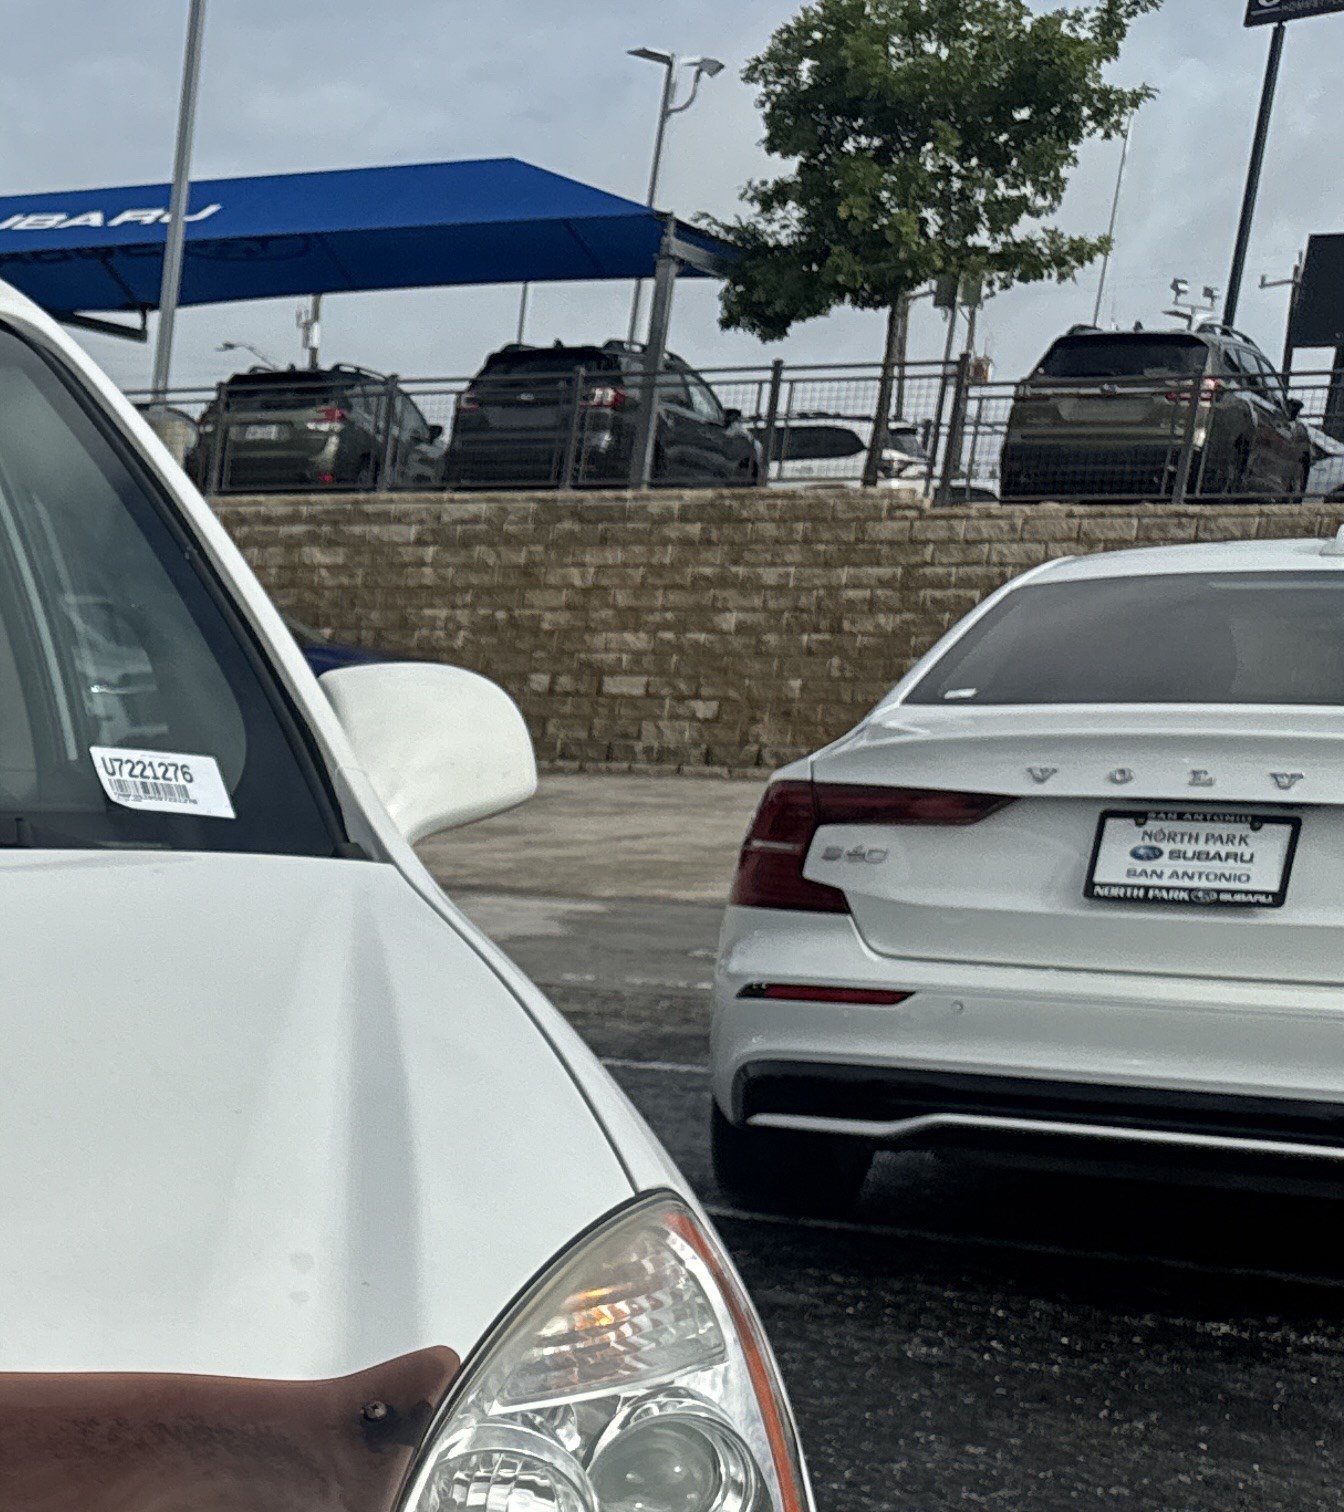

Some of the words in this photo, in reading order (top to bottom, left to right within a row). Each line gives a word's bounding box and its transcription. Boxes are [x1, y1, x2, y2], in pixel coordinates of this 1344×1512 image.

[100, 756, 194, 783] U7221276
[1140, 829, 1200, 845] NORTH
[1204, 830, 1250, 846] PARK
[1167, 849, 1255, 864] SUBARU
[1125, 868, 1163, 881] SAN
[1167, 869, 1251, 885] ANTONIO
[1093, 885, 1145, 899] NORTH
[1148, 887, 1190, 902] PARK
[1219, 892, 1274, 904] SUBARU
